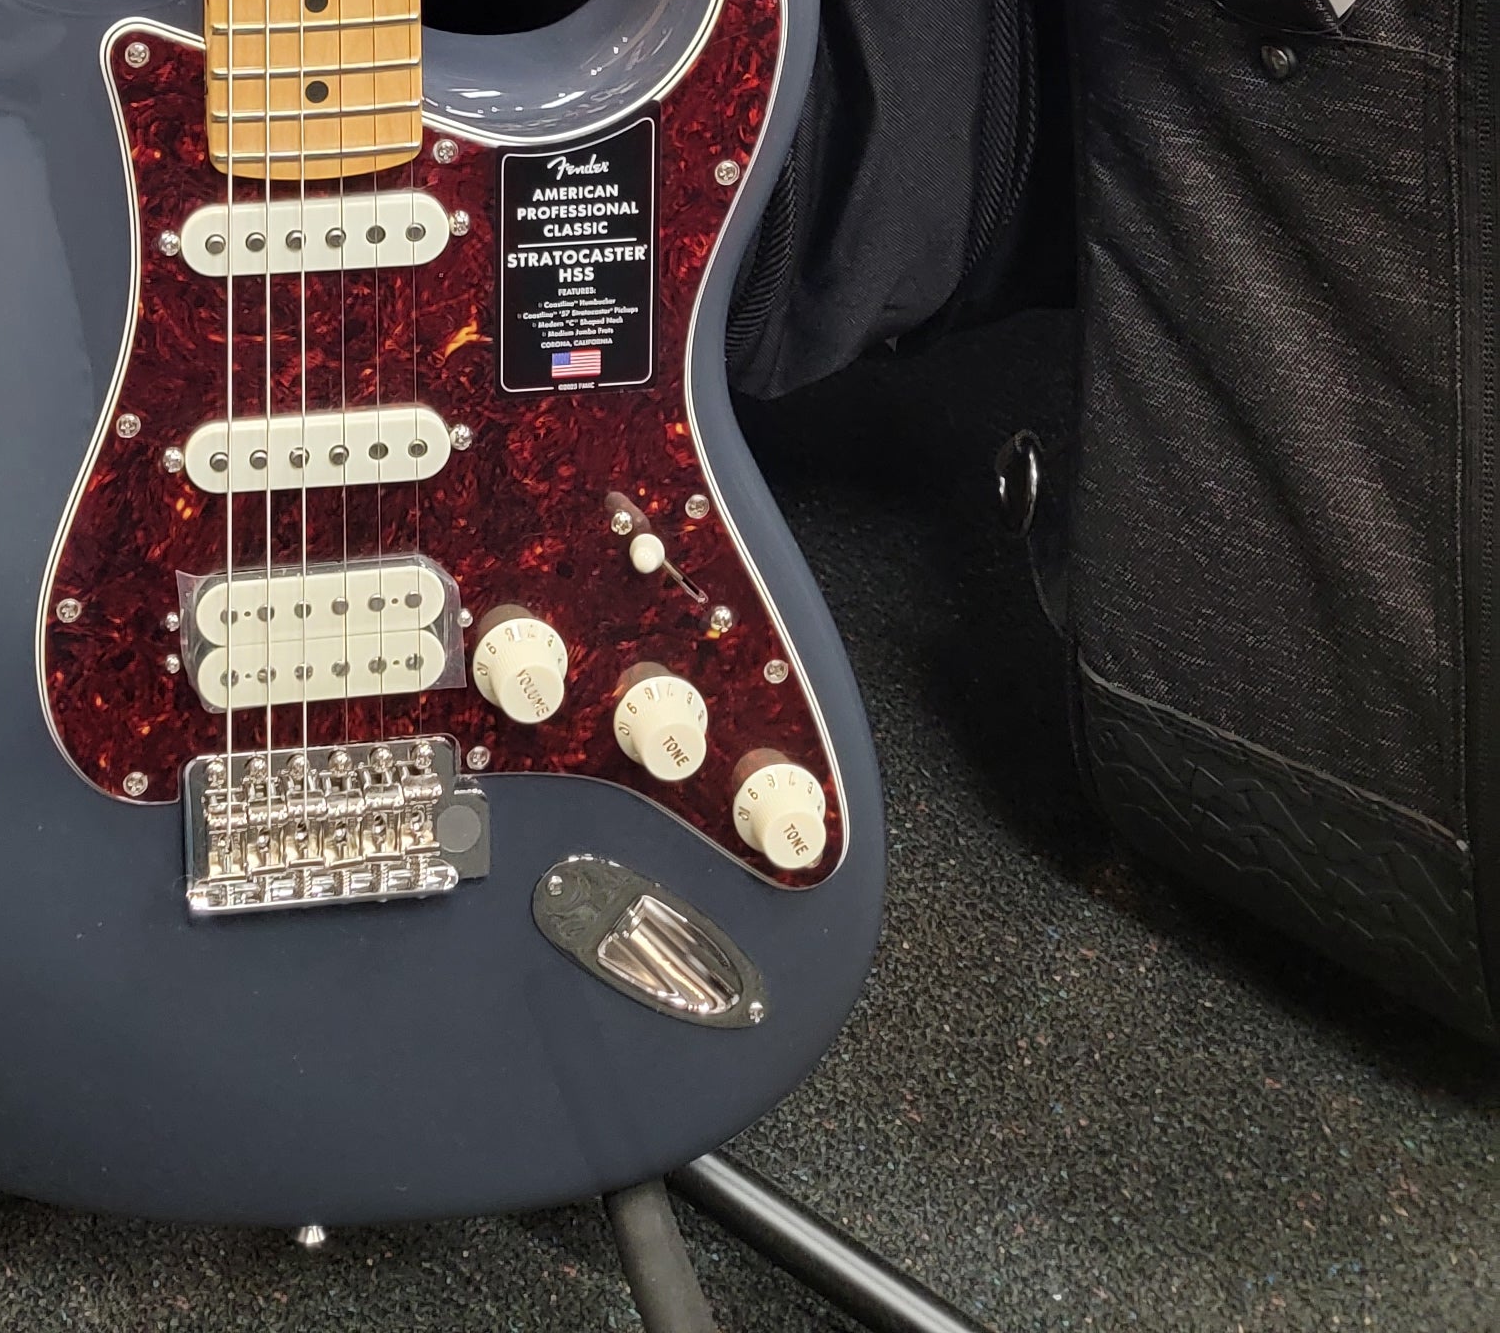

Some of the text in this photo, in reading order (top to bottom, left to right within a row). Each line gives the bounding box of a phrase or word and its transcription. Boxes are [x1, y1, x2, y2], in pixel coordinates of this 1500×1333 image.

[547, 154, 610, 180] Fender
[532, 184, 619, 202] AMERICAN
[517, 201, 639, 221] PROFESSIONAL
[543, 221, 609, 238] CLASSIC
[558, 267, 595, 283] HSS
[516, 669, 550, 717] VOLUME
[662, 735, 690, 767] TONE
[783, 823, 809, 856] TONE
